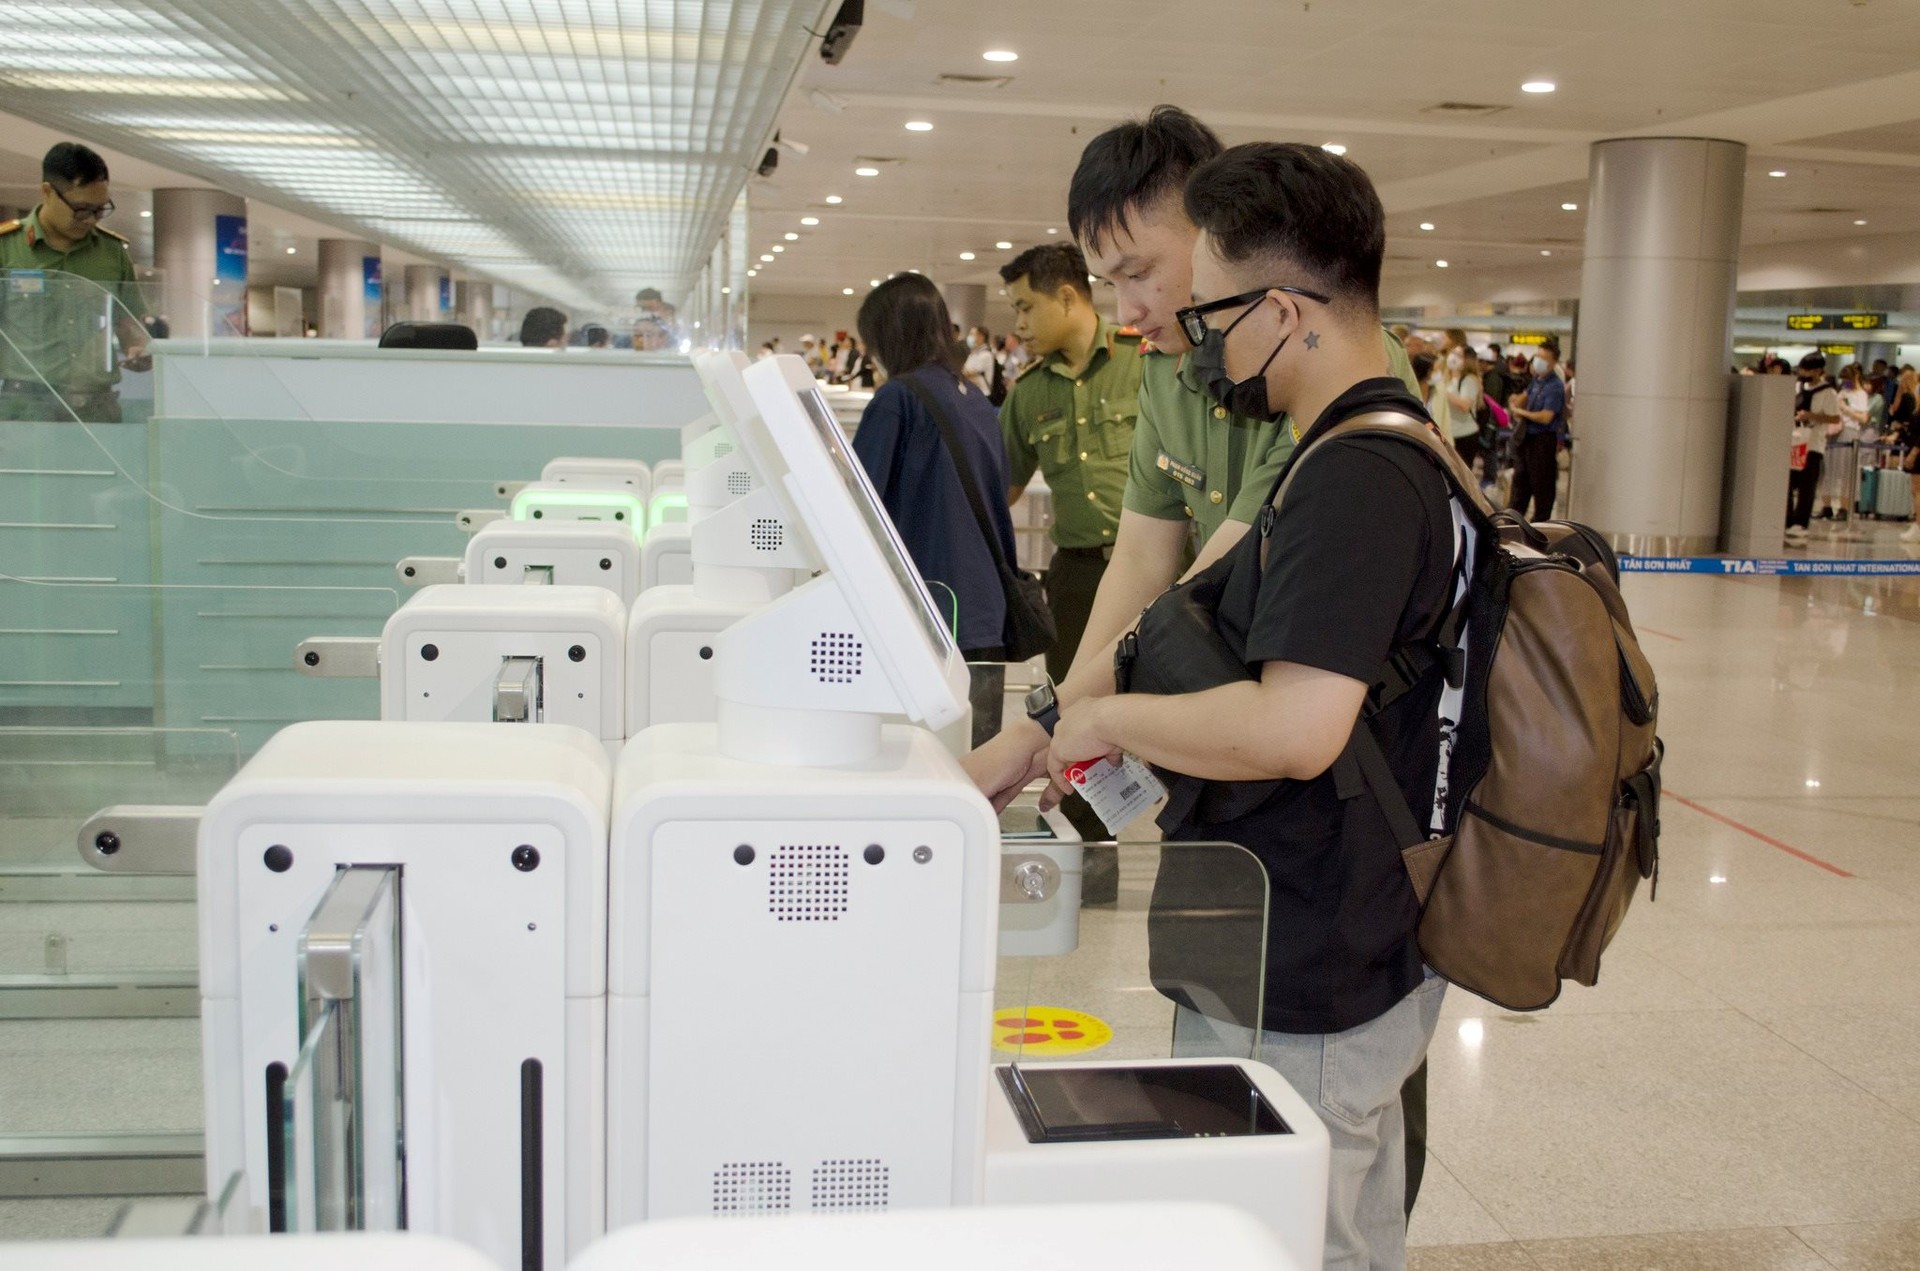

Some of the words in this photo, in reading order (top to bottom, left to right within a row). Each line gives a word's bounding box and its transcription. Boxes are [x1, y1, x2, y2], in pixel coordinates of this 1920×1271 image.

[1623, 558, 1642, 570] TÂN
[1644, 559, 1665, 570] SƠN
[1666, 558, 1692, 571] NHẤT
[1721, 560, 1755, 573] TIA
[1794, 562, 1810, 572] TAN
[1812, 562, 1832, 572] SON
[1833, 563, 1857, 572] NHAT
